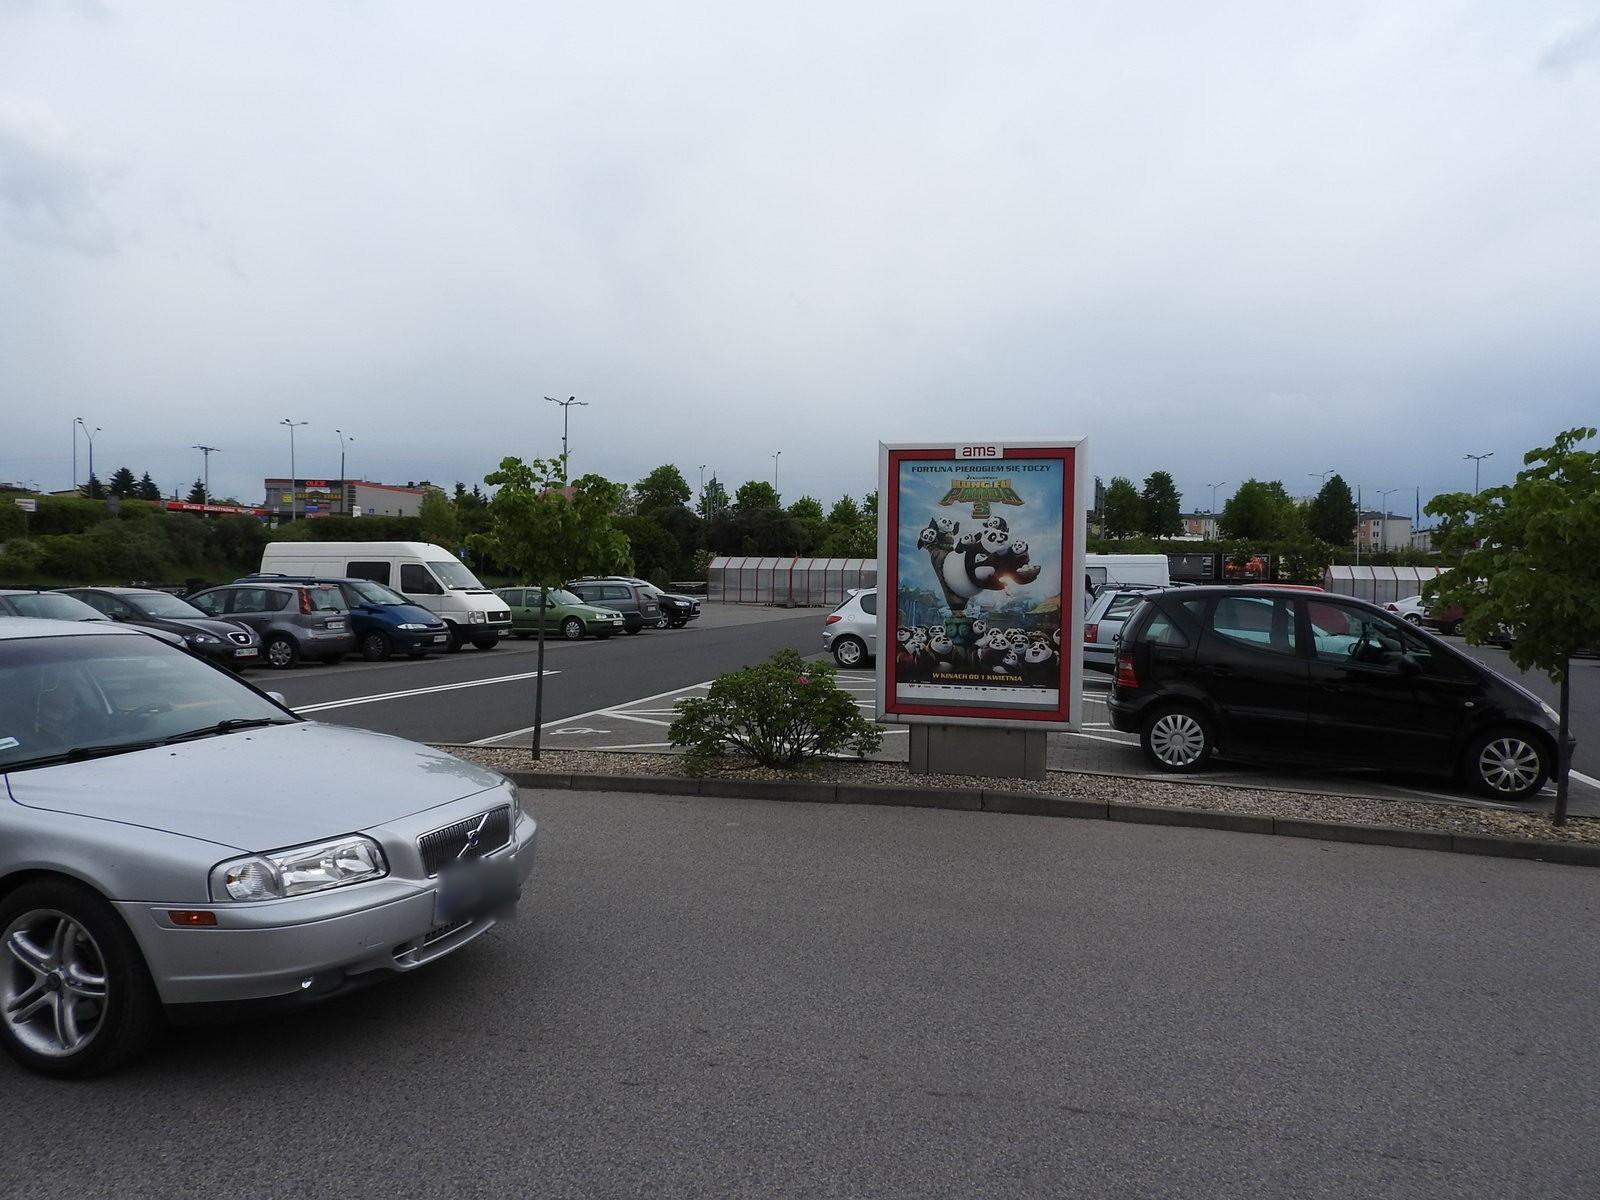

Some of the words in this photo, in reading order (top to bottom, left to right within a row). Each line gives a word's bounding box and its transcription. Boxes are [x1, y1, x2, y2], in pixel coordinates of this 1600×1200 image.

[962, 446, 996, 457] ams
[911, 465, 953, 473] FORTUNA
[955, 465, 1004, 473] PIEROGIEM
[1006, 465, 1021, 473] SIĘ
[1022, 464, 1051, 472] TOCZY
[971, 500, 992, 519] 3
[940, 672, 969, 680] KINACH
[987, 674, 1023, 682] KWIETNIA
